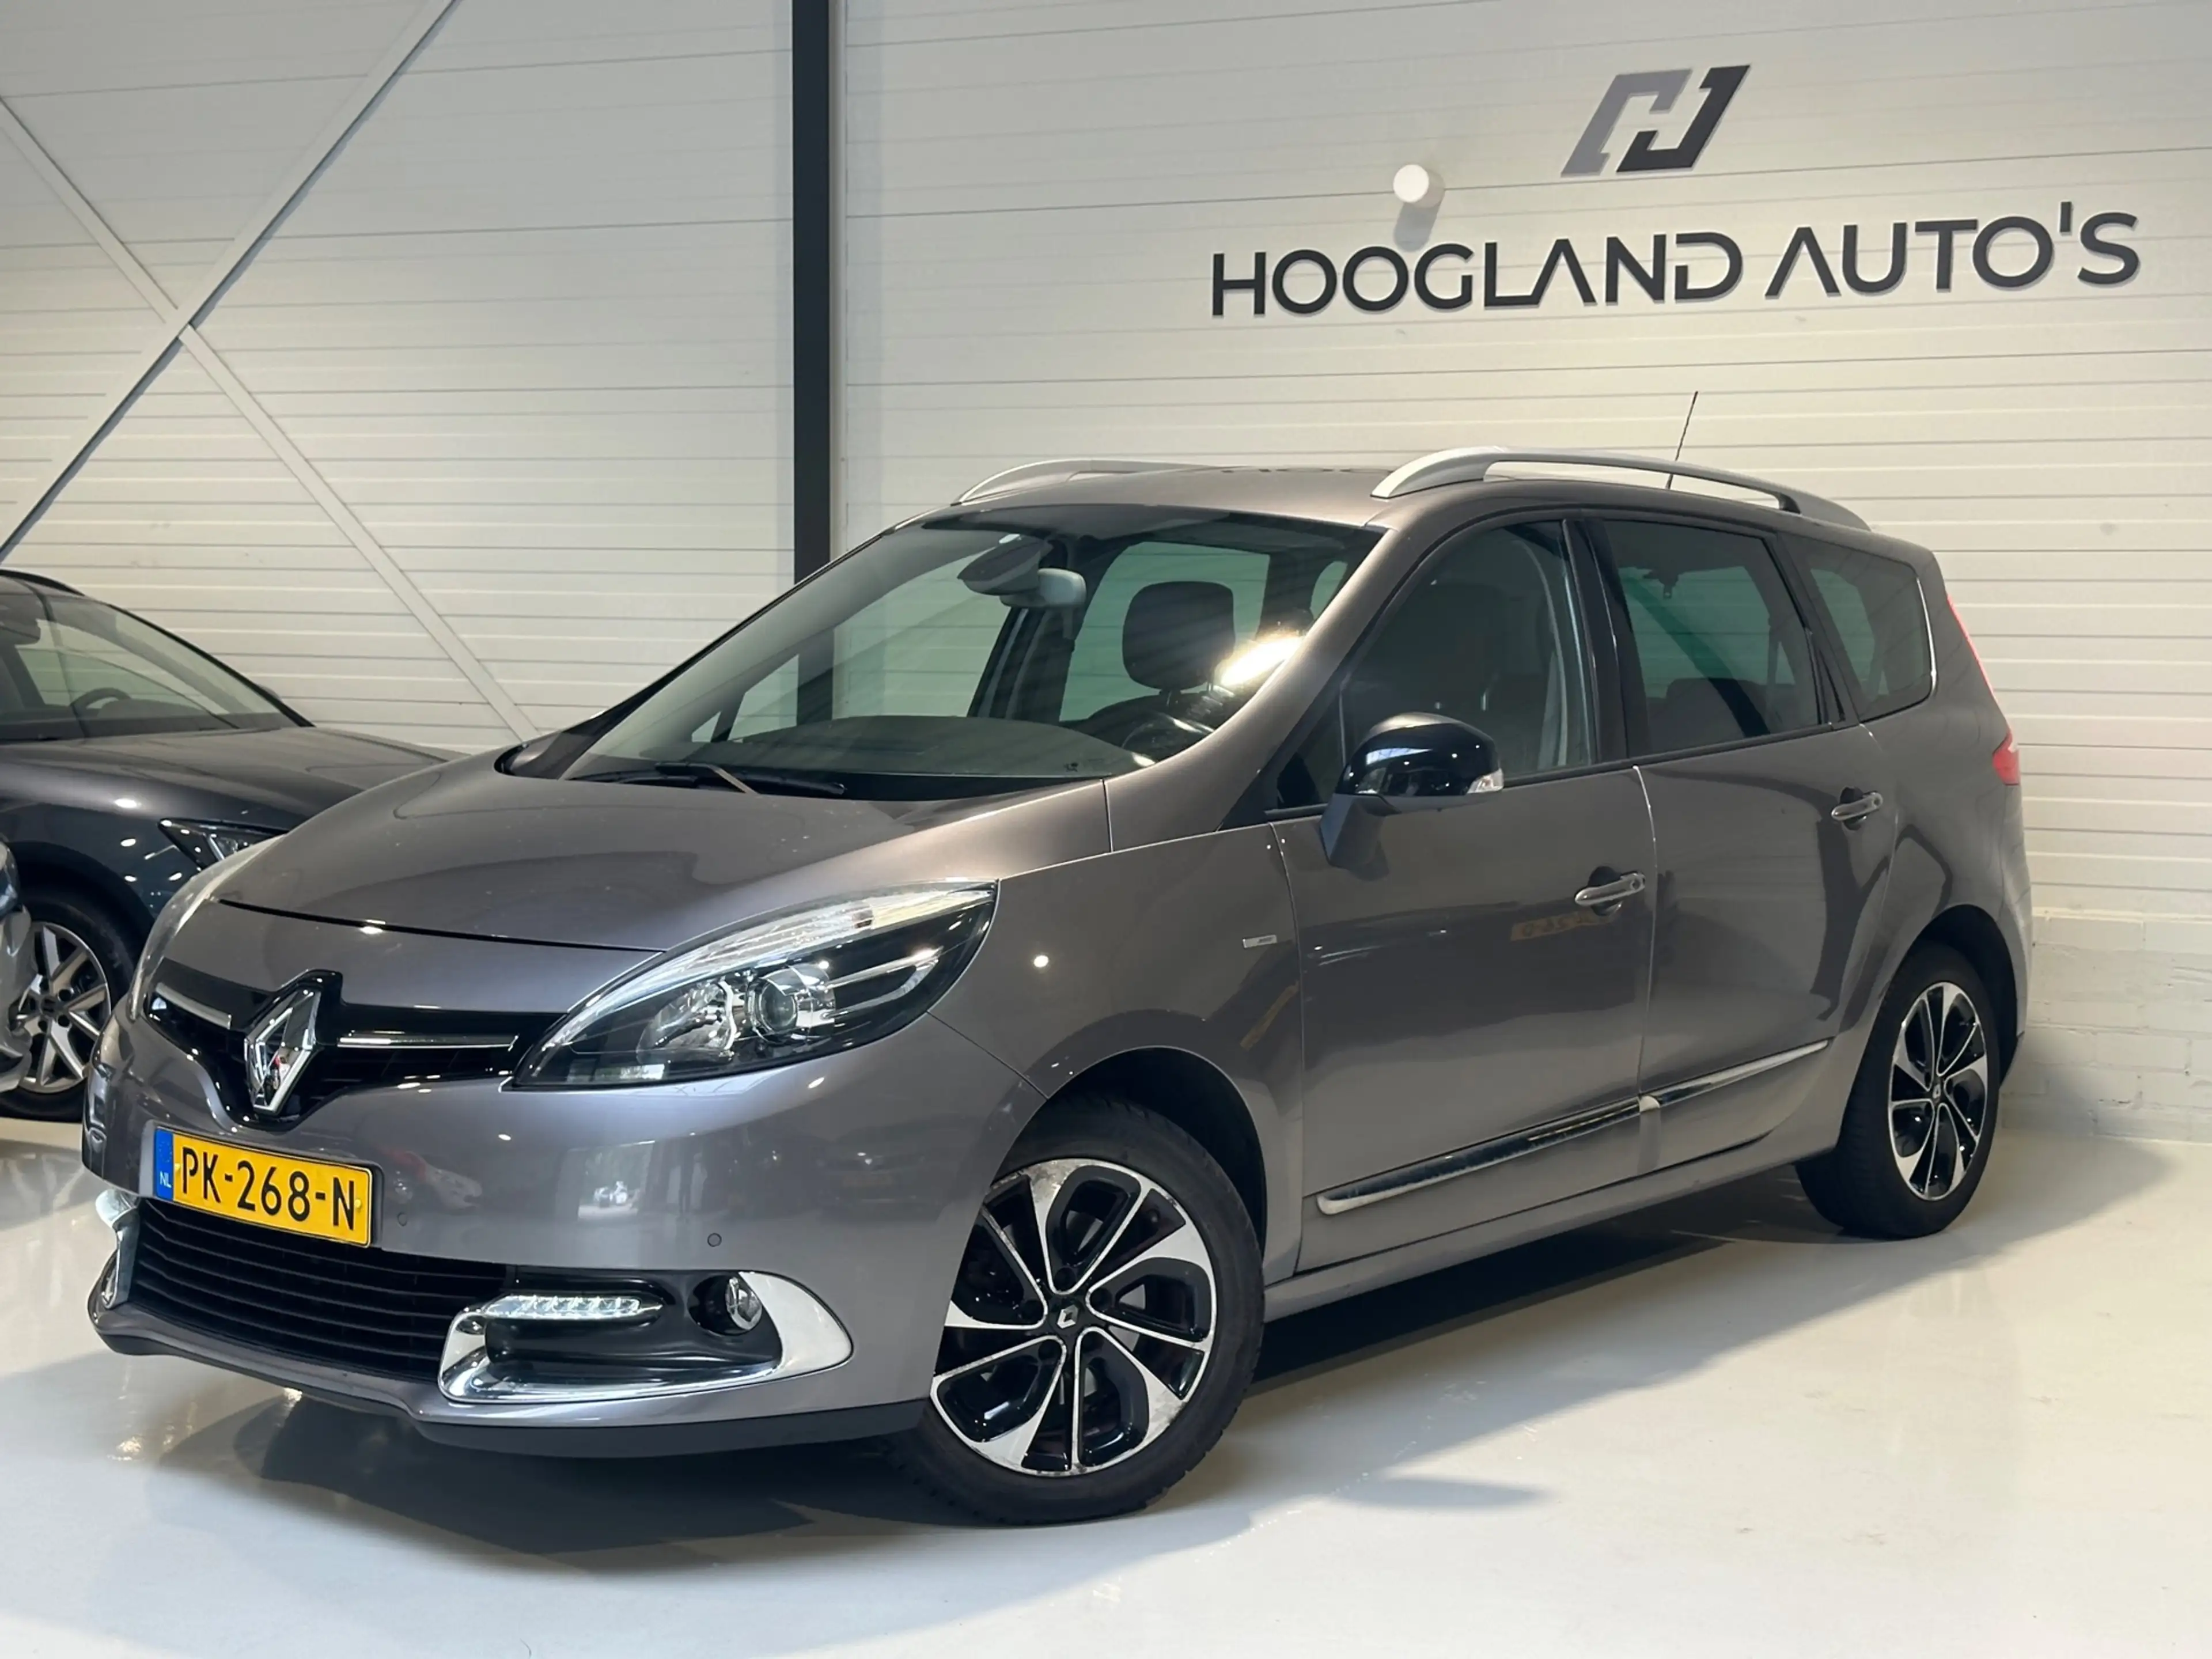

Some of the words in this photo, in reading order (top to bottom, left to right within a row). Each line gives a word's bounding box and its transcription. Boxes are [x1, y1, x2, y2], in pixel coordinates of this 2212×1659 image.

[1213, 232, 1743, 317] HOOGLAND
[1765, 202, 2140, 298] AUTO'S
[160, 1172, 172, 1189] NL
[182, 1146, 354, 1230] PK-268-N
